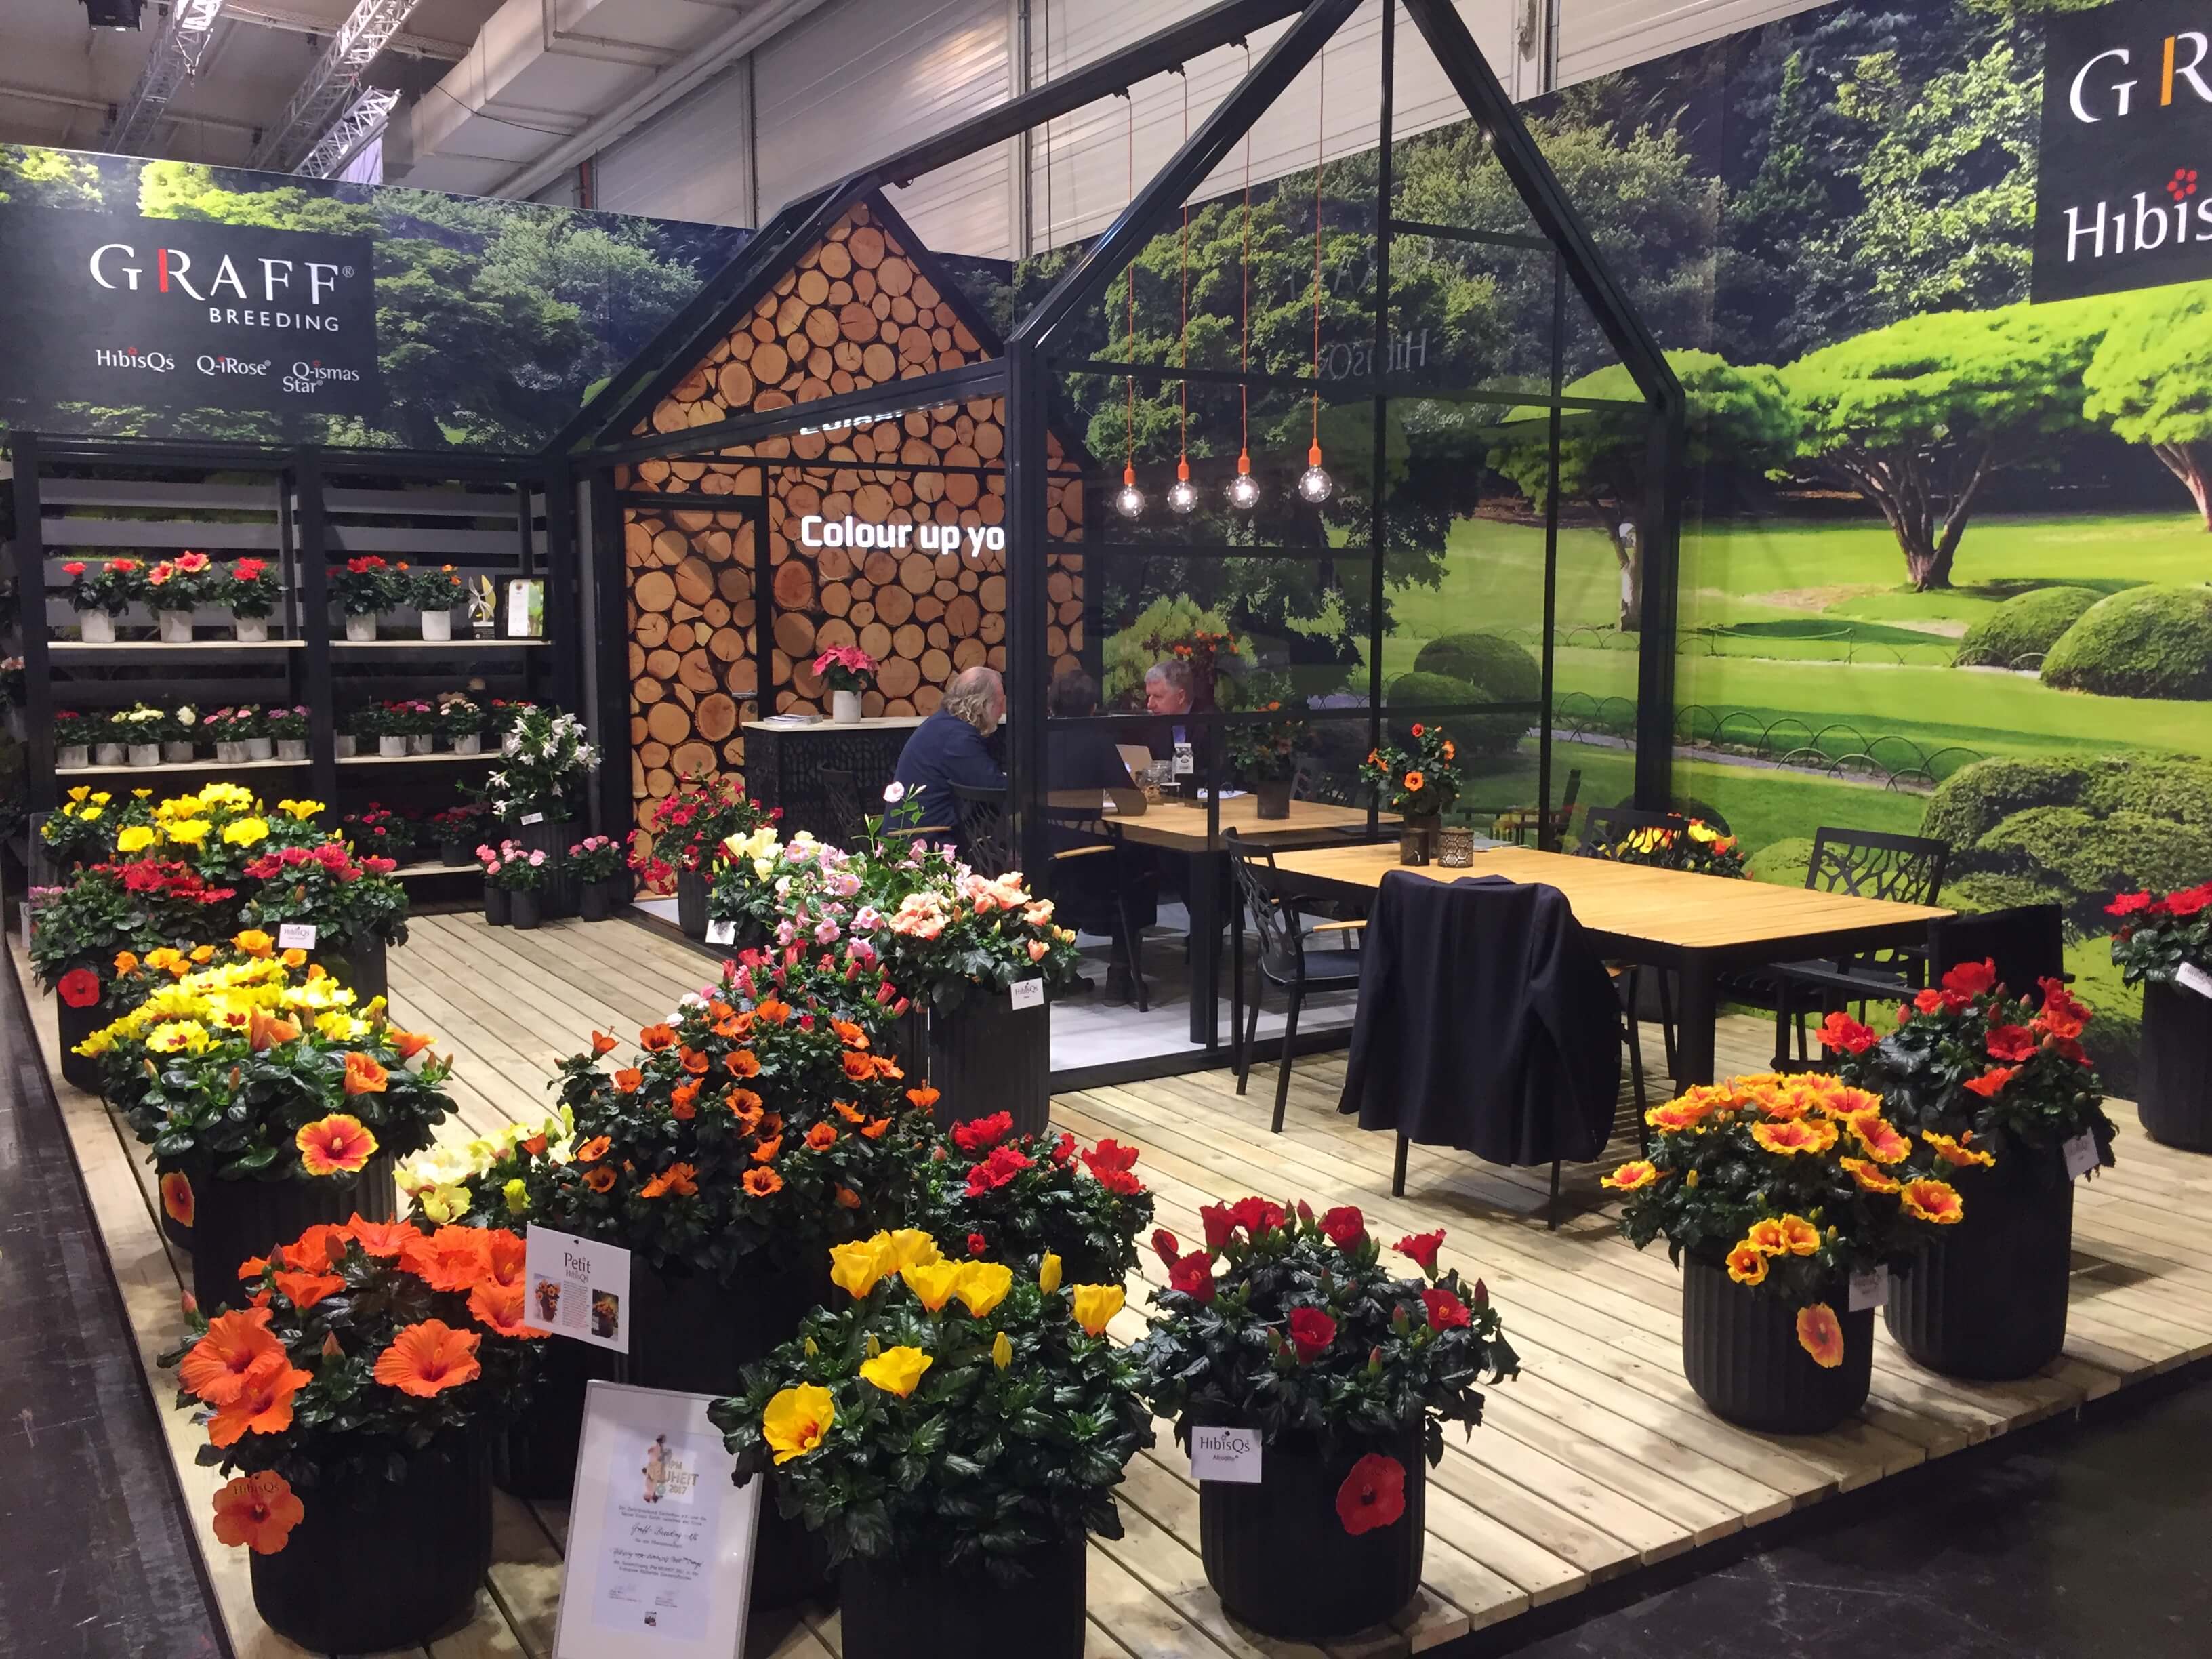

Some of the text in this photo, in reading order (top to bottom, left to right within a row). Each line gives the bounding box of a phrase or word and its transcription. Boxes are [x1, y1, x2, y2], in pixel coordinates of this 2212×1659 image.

[89, 243, 339, 304] GRAFF
[209, 308, 340, 331] BREEDING
[96, 348, 175, 372] HibisQs
[801, 515, 1004, 557] Colour up yo
[564, 1252, 591, 1274] Petit
[1200, 1436, 1250, 1454] HibisQs
